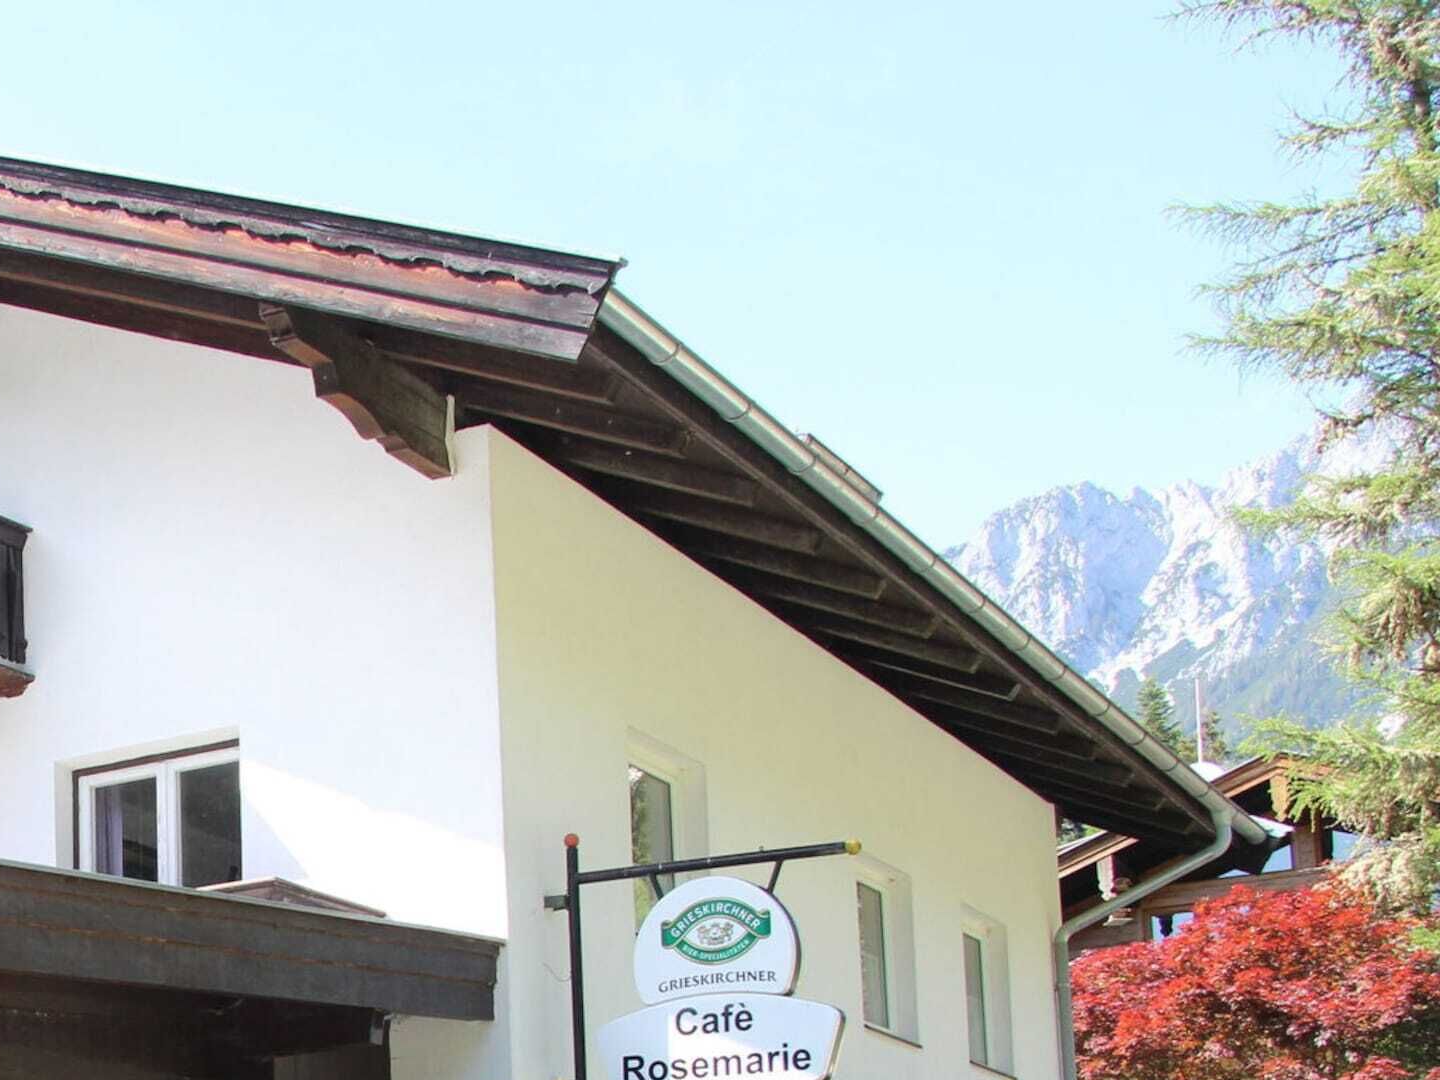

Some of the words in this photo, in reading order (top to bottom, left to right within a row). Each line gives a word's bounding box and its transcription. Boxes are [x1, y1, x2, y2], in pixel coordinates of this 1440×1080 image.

[670, 902, 762, 938] GRIESKIRCHNER
[658, 969, 777, 993] GRIESKIRCHNER
[675, 1002, 754, 1036] Cafè
